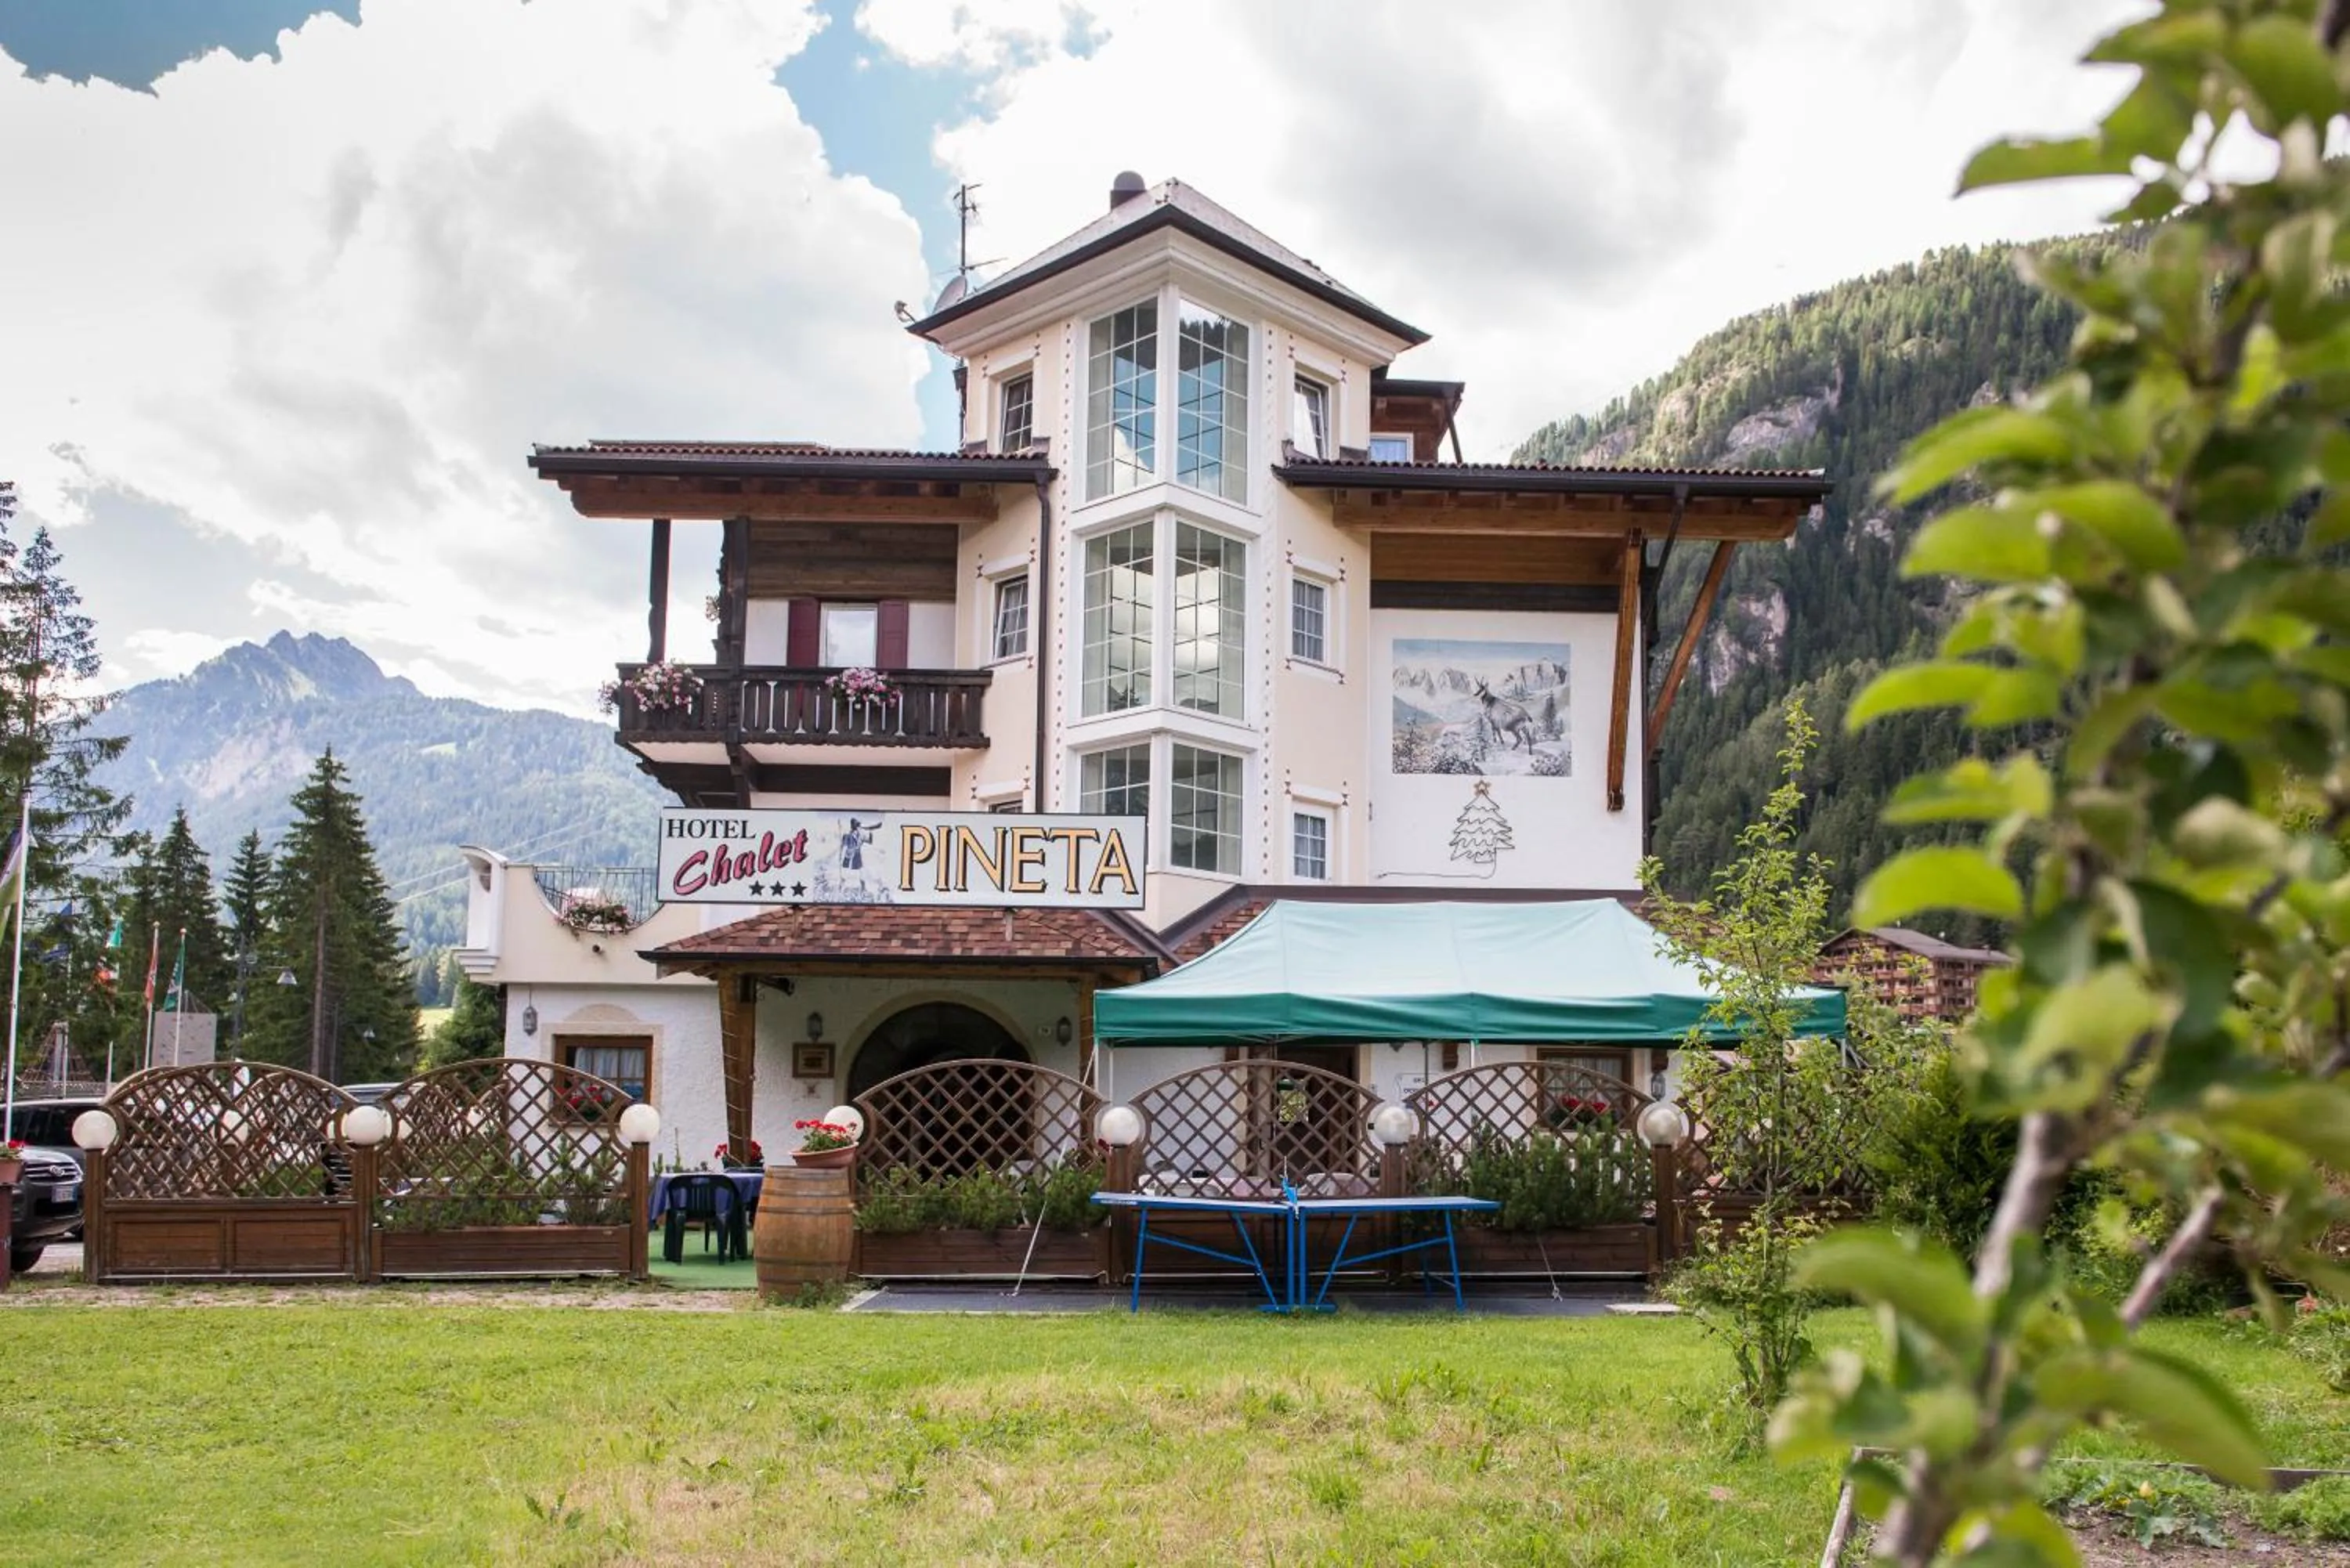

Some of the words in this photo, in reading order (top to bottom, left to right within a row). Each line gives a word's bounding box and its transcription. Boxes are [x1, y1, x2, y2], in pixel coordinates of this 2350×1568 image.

[666, 818, 757, 839] HOTEL
[674, 828, 808, 895] Chalet
[898, 825, 1139, 894] PINETA
